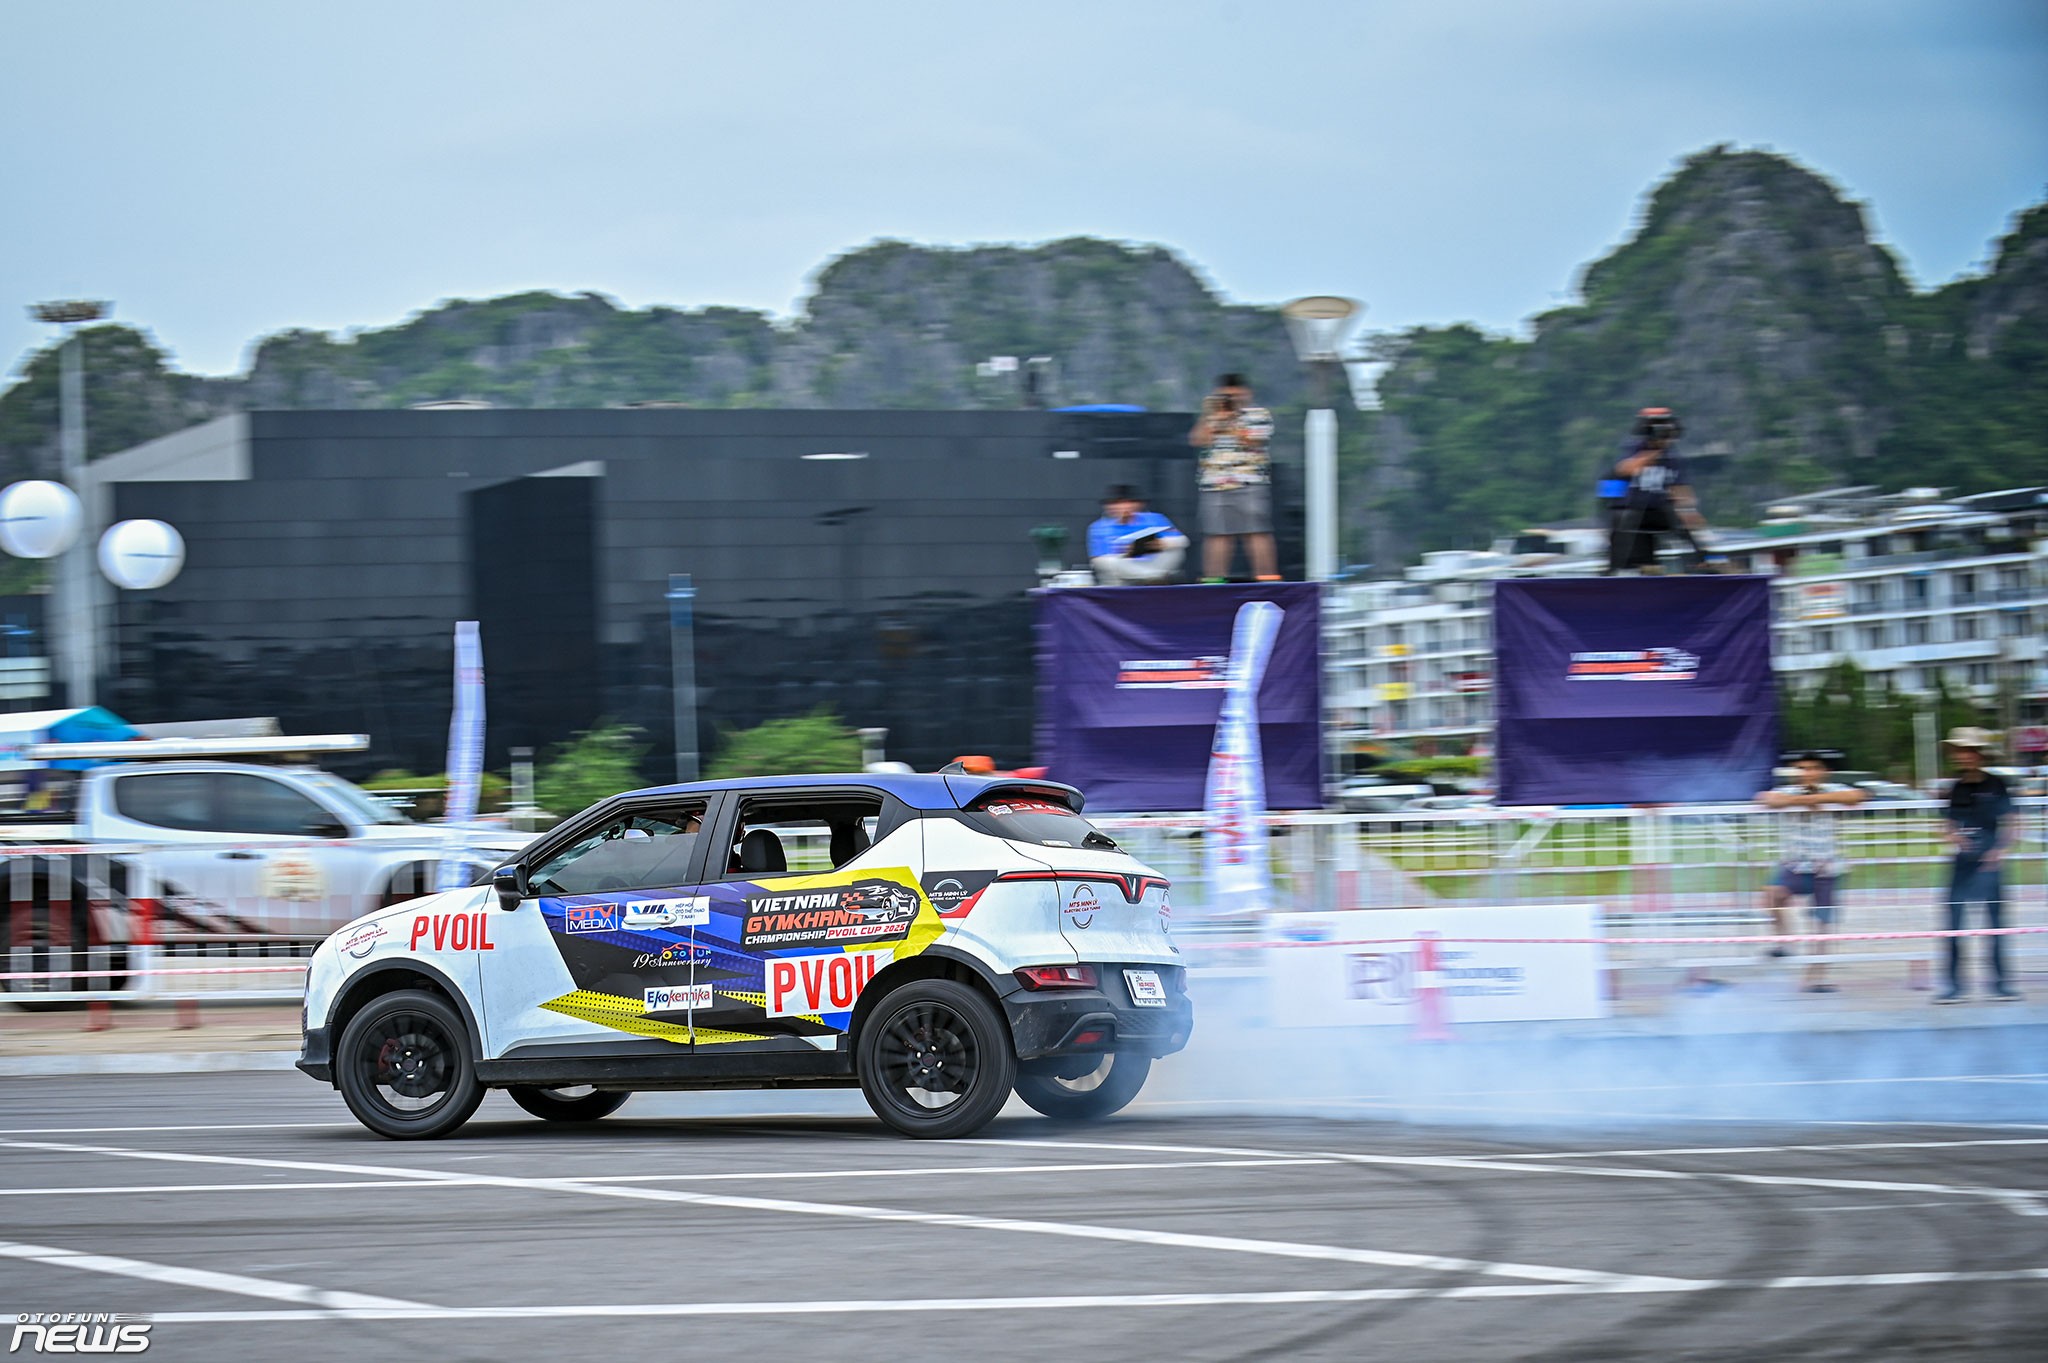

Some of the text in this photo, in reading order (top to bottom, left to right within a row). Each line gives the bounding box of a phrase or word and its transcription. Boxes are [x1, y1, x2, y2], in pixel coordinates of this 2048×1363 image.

[751, 893, 839, 913] VIETNAM
[410, 913, 495, 951] PVOIL
[569, 918, 615, 931] MEDIA
[746, 910, 865, 933] GYMKHANA
[745, 923, 905, 945] CHAMPIONSHIP PVOIL CUP 2025
